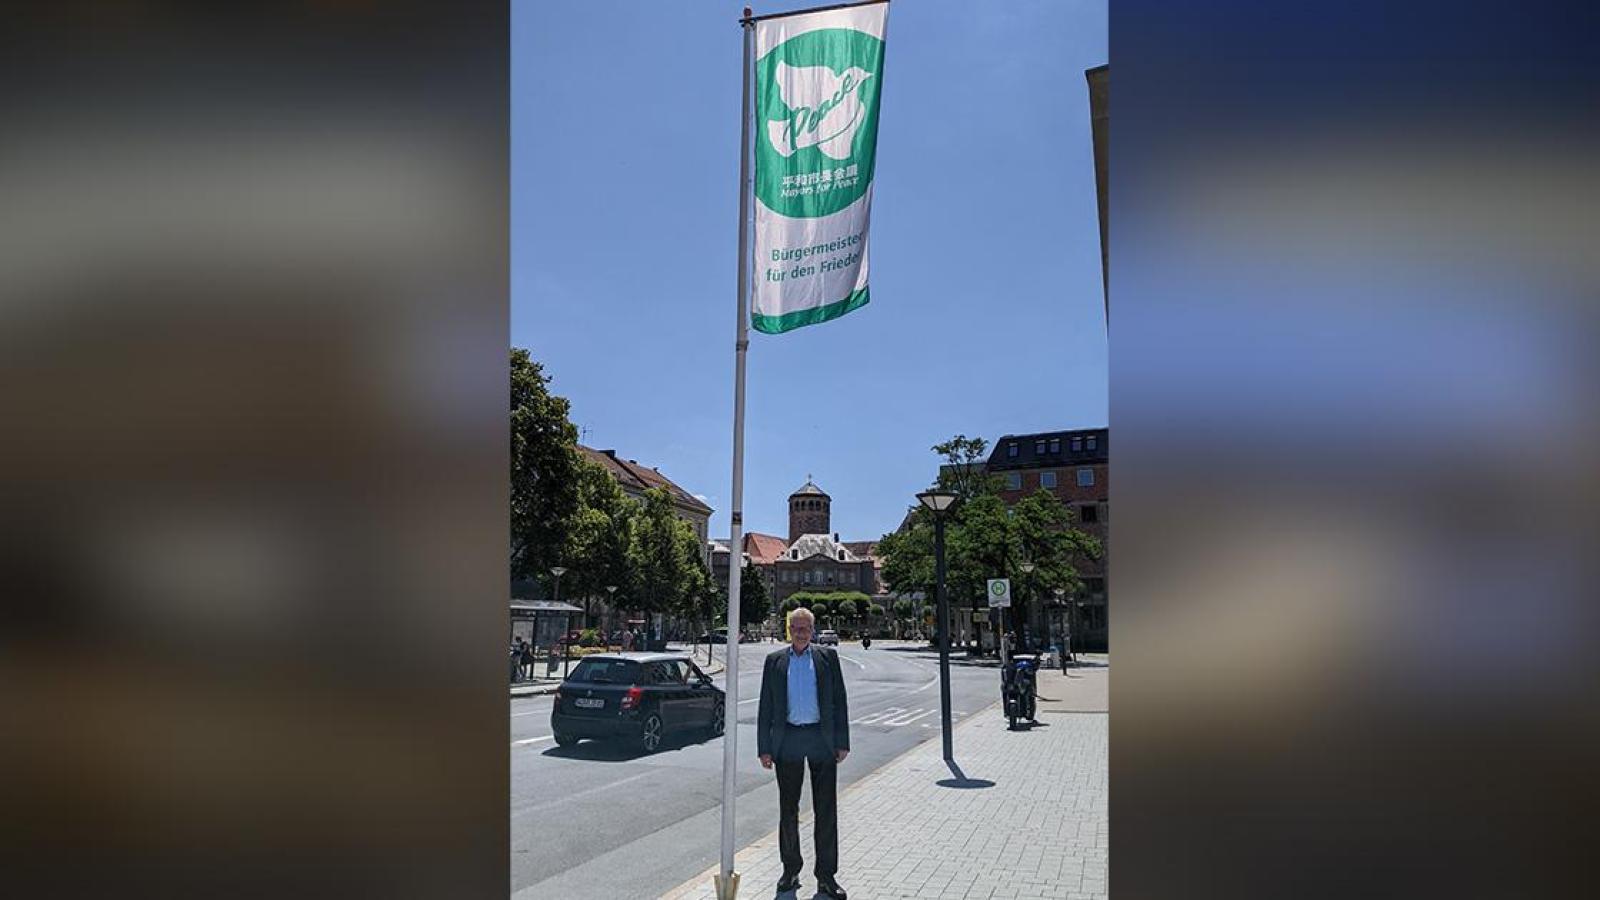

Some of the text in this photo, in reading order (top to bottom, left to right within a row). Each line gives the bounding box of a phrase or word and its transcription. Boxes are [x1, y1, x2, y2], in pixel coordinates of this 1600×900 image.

[783, 74, 859, 150] Peace
[816, 183, 830, 194] for
[772, 232, 863, 261] Bürgermeister
[766, 252, 861, 281] für den Friede
